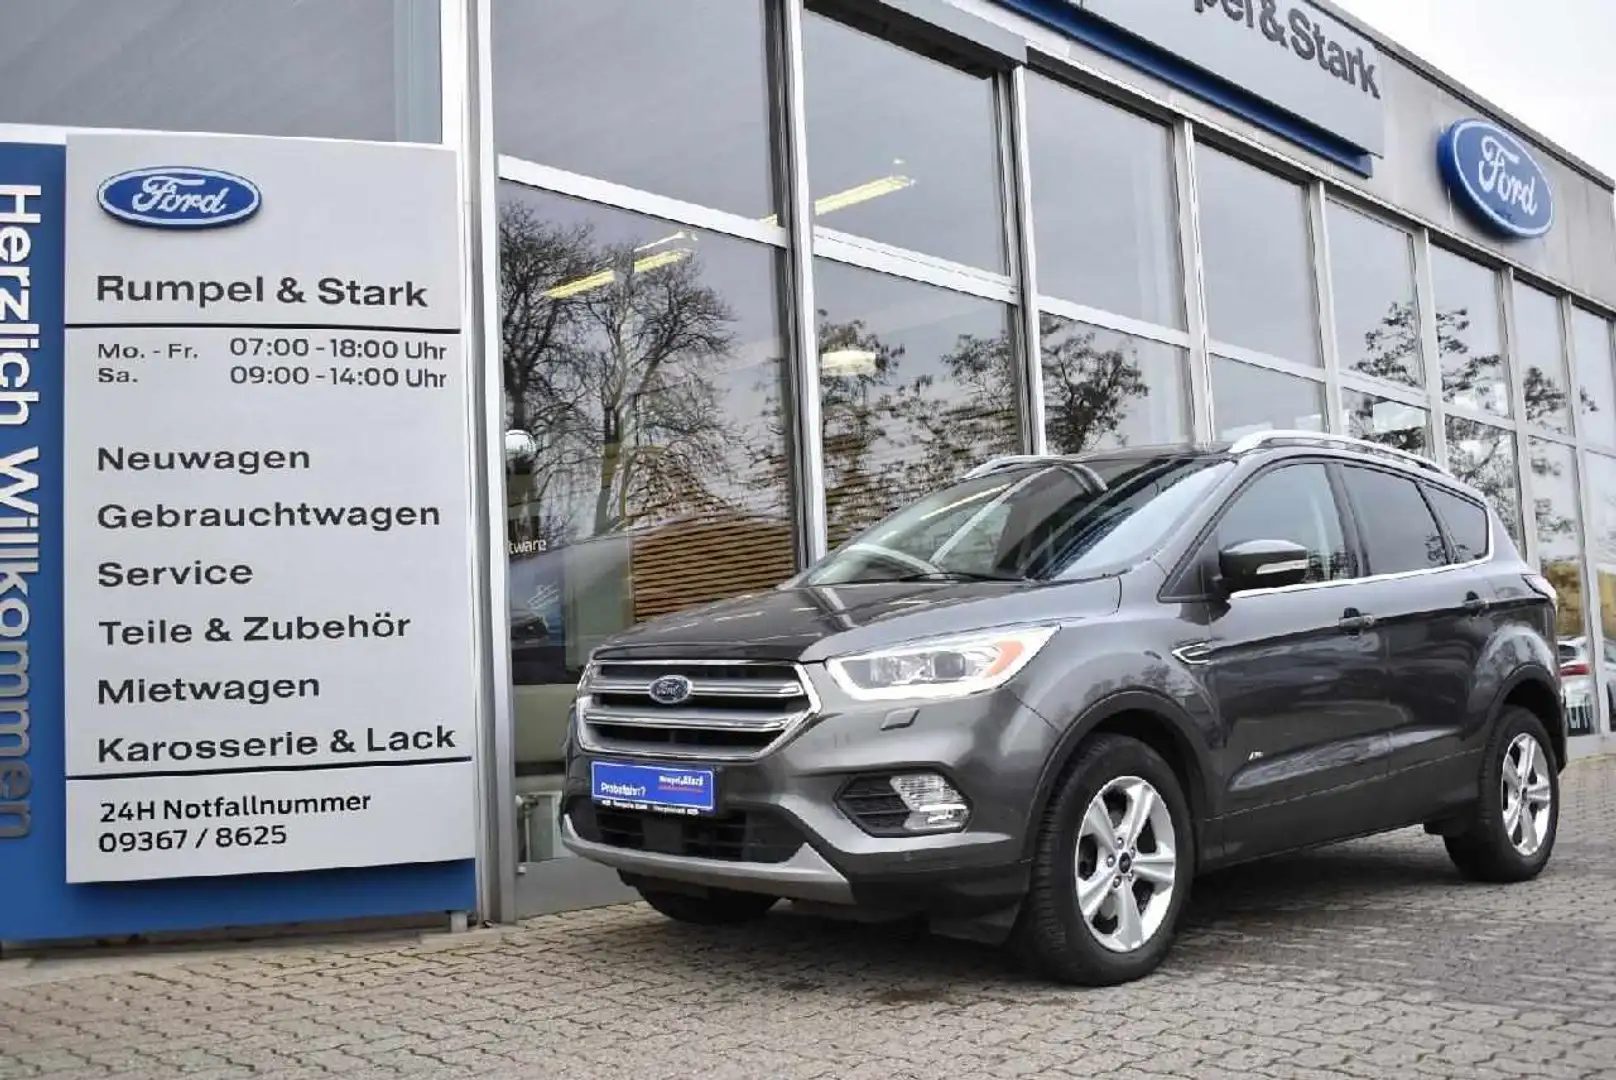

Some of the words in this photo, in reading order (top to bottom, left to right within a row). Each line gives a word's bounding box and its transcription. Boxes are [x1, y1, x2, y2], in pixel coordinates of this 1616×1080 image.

[1479, 136, 1538, 216] Ford
[132, 175, 230, 213] Ford
[0, 184, 41, 425] Herzlich
[97, 275, 264, 309] Rumpel
[277, 276, 307, 304] &
[318, 277, 428, 307] Stark
[98, 343, 145, 359] Mo.
[168, 343, 198, 359] Fr.
[405, 342, 447, 360] Uhr
[98, 367, 138, 383] Sa.
[405, 370, 447, 388] Uhr
[98, 446, 310, 475] Neuwagen
[98, 501, 440, 532] Gebrauchtwagen
[98, 559, 253, 587] Service
[0, 445, 39, 838] Willkommen
[99, 619, 193, 645] Teile
[204, 617, 232, 642] &
[243, 612, 411, 642] Zubehör
[98, 677, 320, 705] Mietwagen
[98, 731, 319, 763] Karosserie
[329, 729, 356, 753] &
[367, 725, 456, 752] Lack
[99, 800, 155, 823] 24H
[163, 794, 371, 820] Notfallnummer
[98, 829, 188, 853] 09367
[215, 825, 287, 848] 8625
